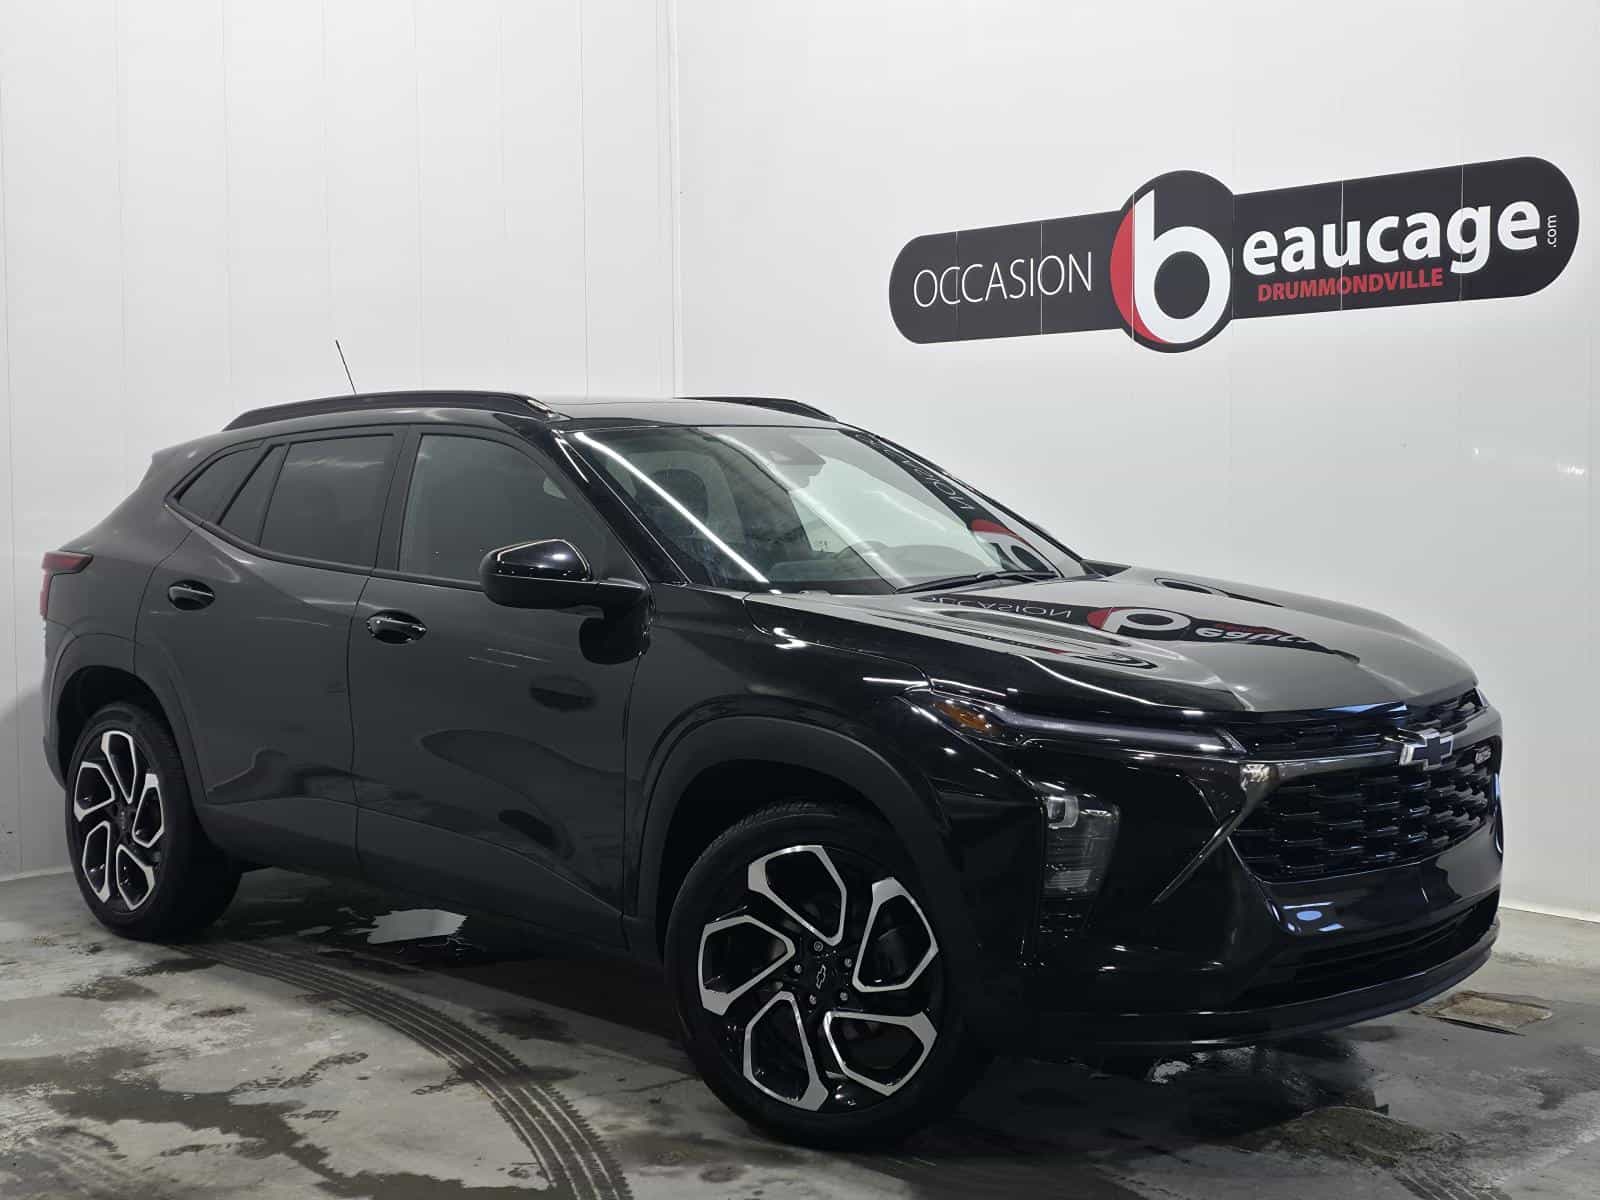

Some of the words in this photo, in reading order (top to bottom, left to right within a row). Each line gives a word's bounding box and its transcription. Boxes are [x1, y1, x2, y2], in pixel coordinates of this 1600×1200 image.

[1547, 214, 1558, 248] .com
[913, 250, 1092, 308] OCCASION
[1131, 189, 1541, 345] beaucage
[1257, 267, 1444, 303] DRUMMONDVILLE
